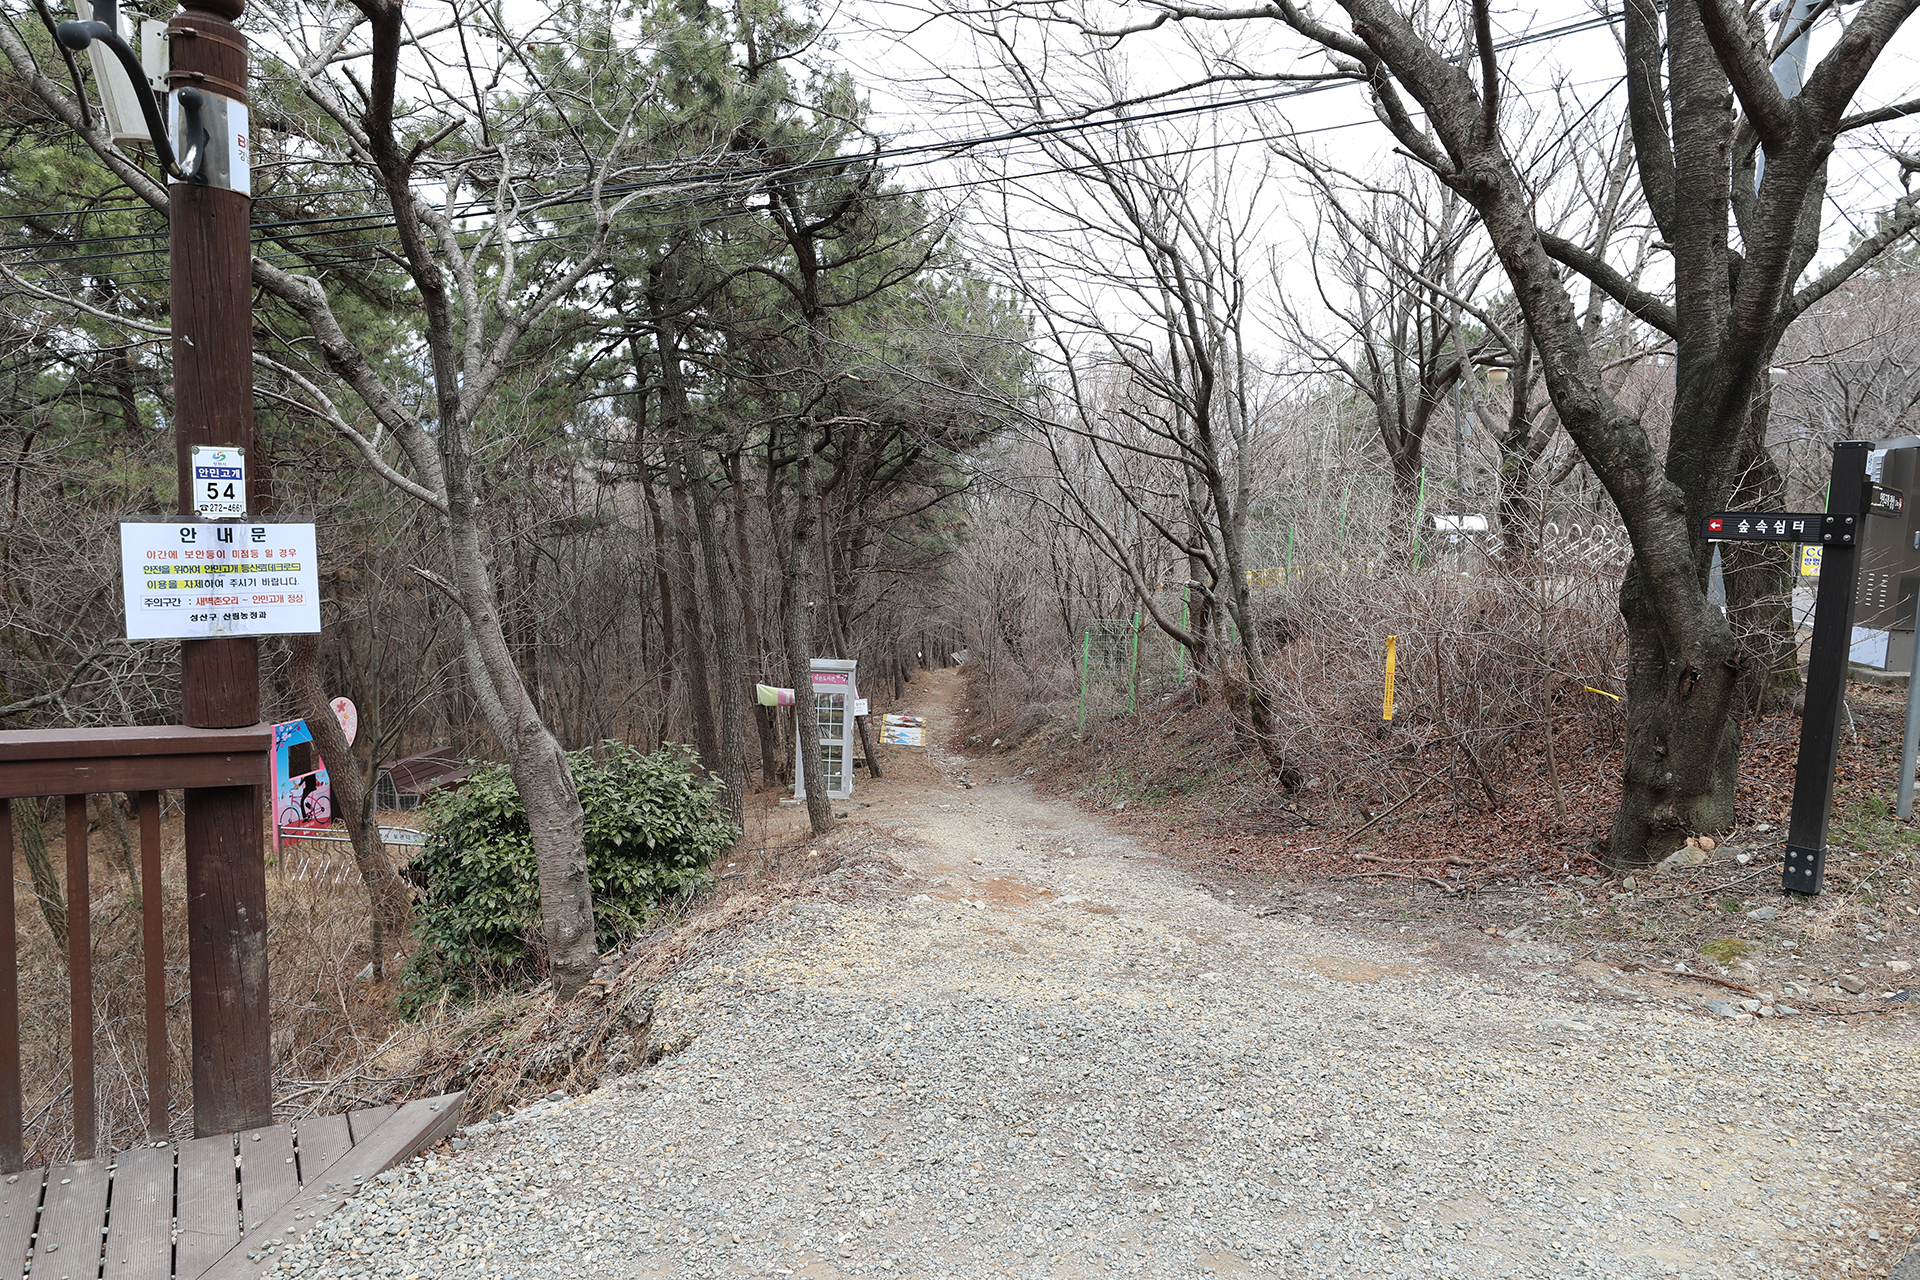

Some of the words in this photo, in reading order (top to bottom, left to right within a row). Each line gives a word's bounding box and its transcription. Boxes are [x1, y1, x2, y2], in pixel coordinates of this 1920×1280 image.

[198, 467, 241, 479] 안민고개
[206, 482, 236, 500] 54
[1737, 518, 1805, 535] 숲속쉼터
[146, 550, 178, 560] 야간에
[184, 549, 226, 560] 보안등이
[231, 548, 259, 559] 미점등
[264, 548, 274, 559] 일
[278, 547, 297, 559] 경우
[143, 564, 171, 575] 안전을
[173, 564, 201, 575] 위하여
[204, 564, 239, 575] 안민고개
[146, 579, 178, 590] 이용을
[183, 578, 224, 590] 자제하여
[229, 577, 257, 588] 주시기
[261, 576, 300, 587] 바랍니다.
[144, 597, 181, 608] 주의구간
[251, 594, 285, 605] 안민고개
[287, 593, 304, 604] 정상
[189, 612, 218, 623] 성산구
[222, 610, 267, 621] 산림농정과
